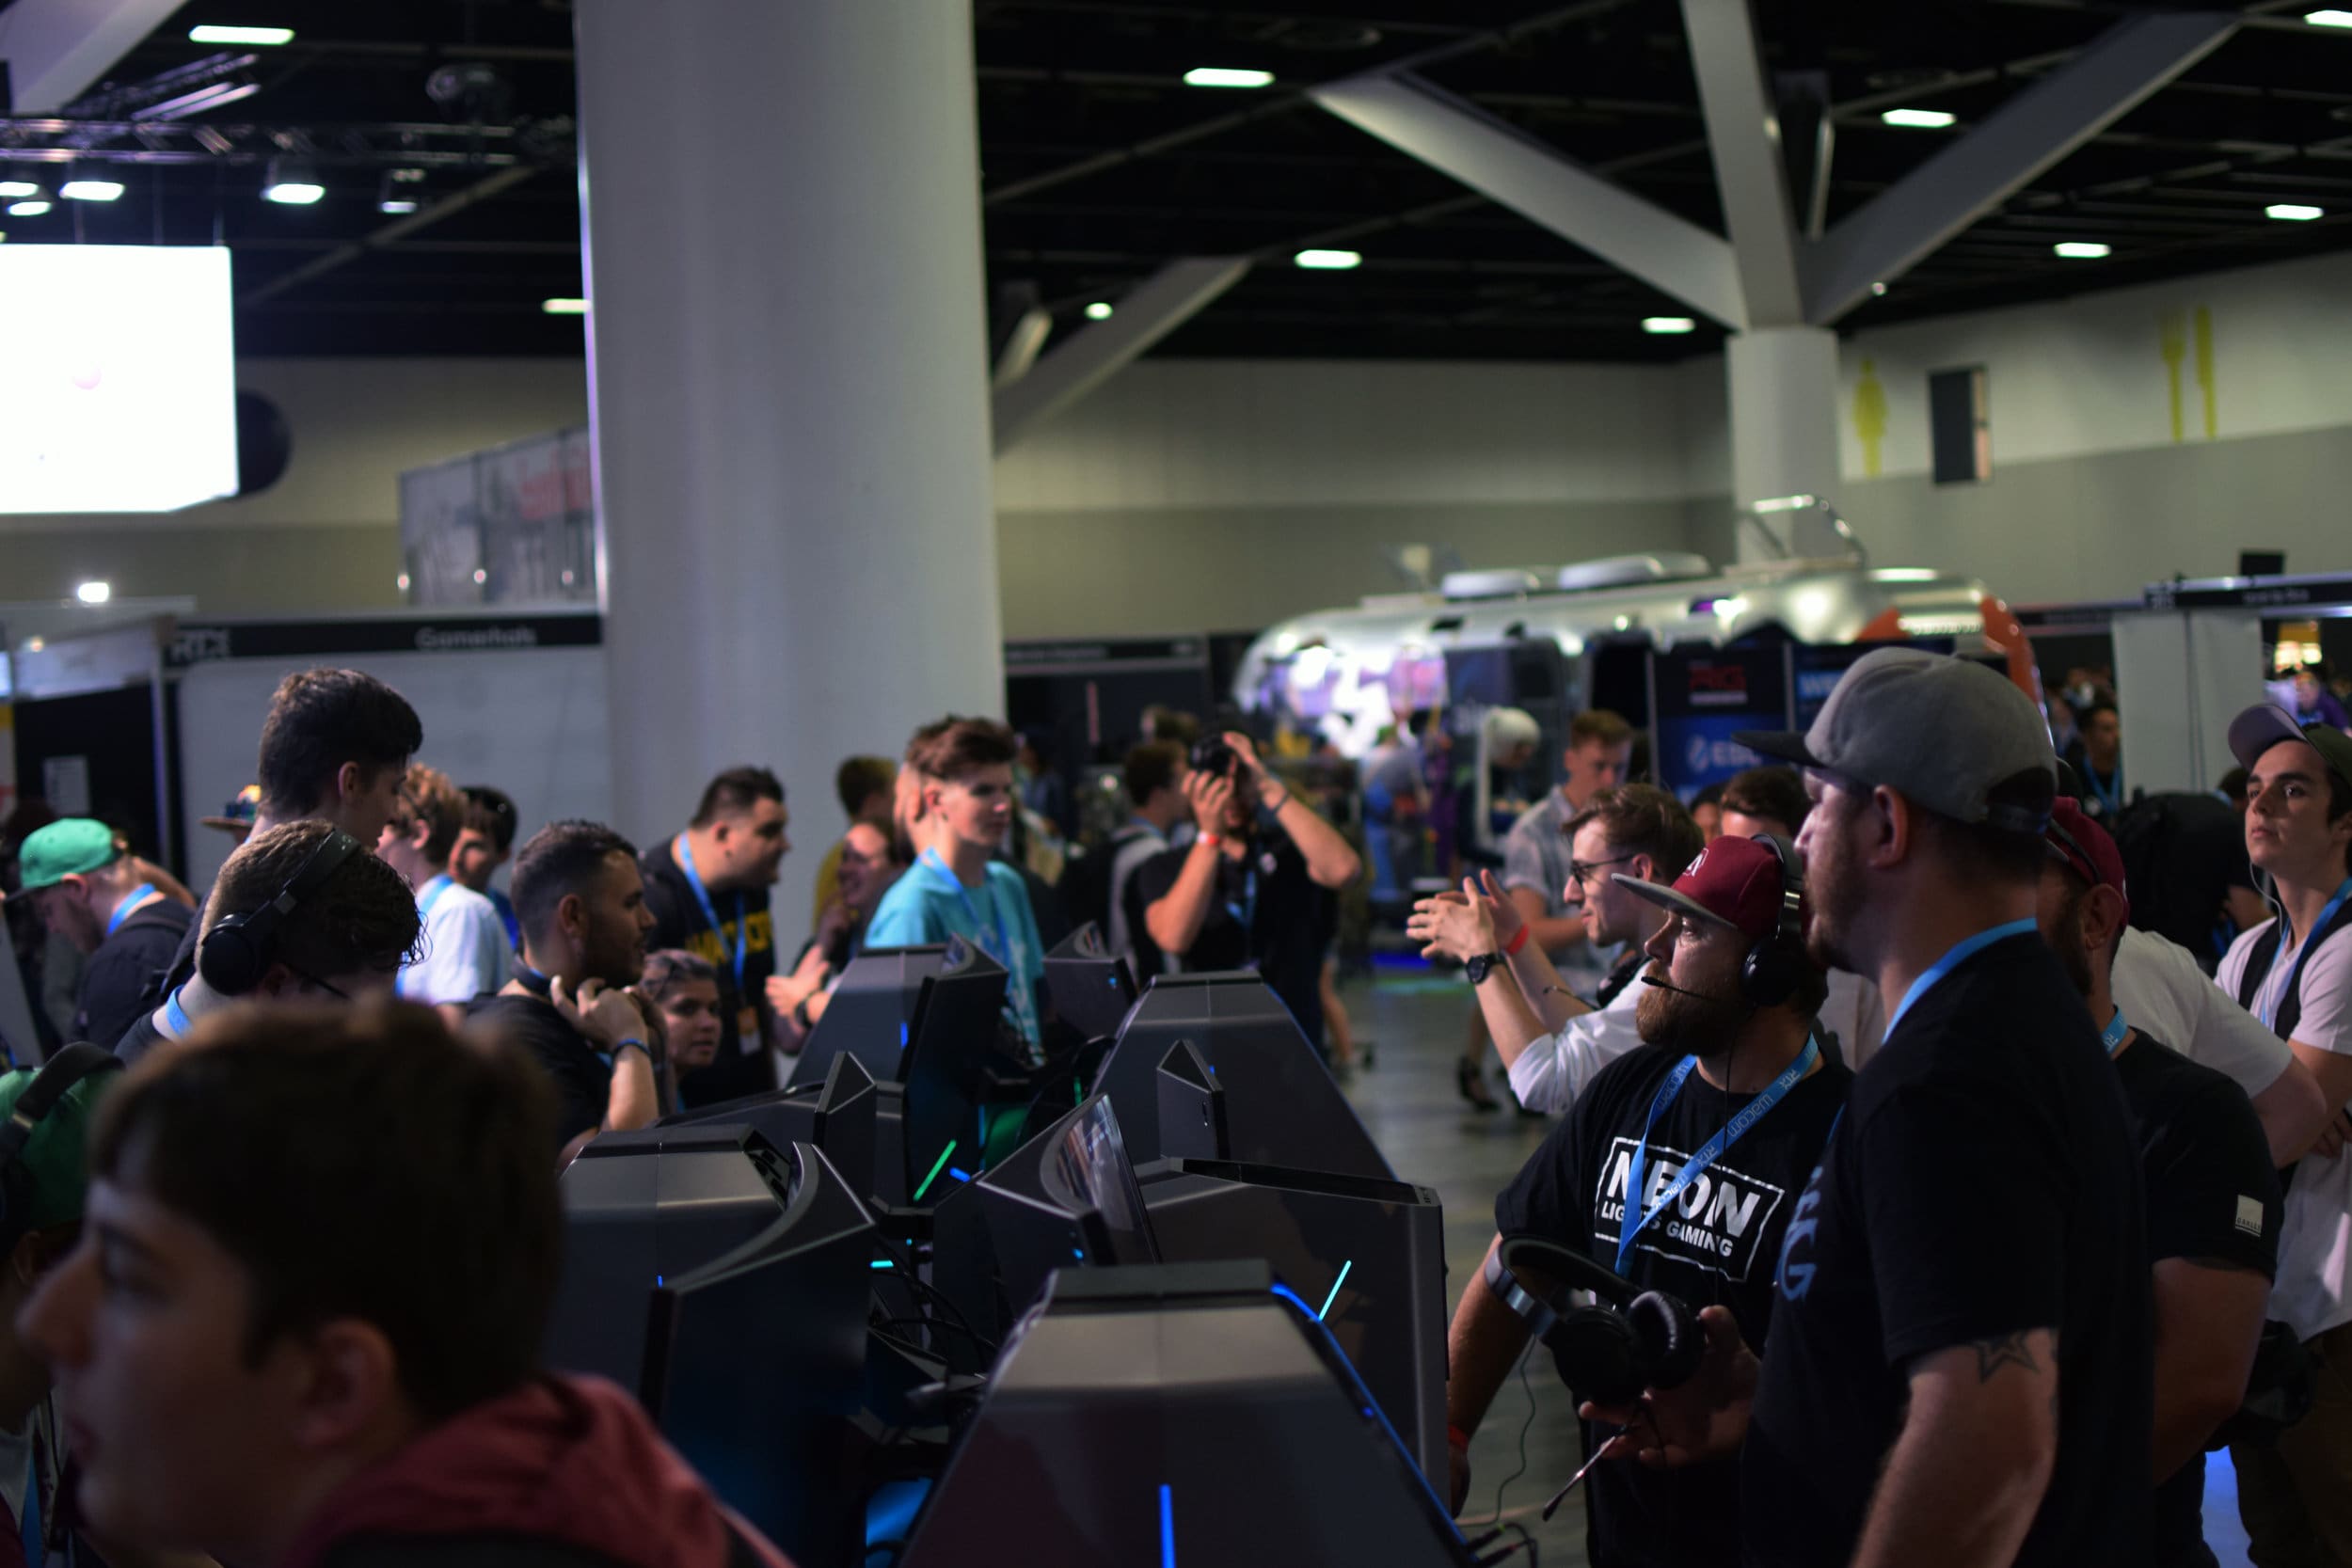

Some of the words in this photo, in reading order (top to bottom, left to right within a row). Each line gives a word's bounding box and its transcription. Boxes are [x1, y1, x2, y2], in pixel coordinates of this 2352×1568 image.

[1727, 1094, 1773, 1136] wacom
[1607, 1150, 1759, 1239] NEON
[1601, 1200, 1661, 1230] LIGS
[1666, 1219, 1733, 1258] GAMING
